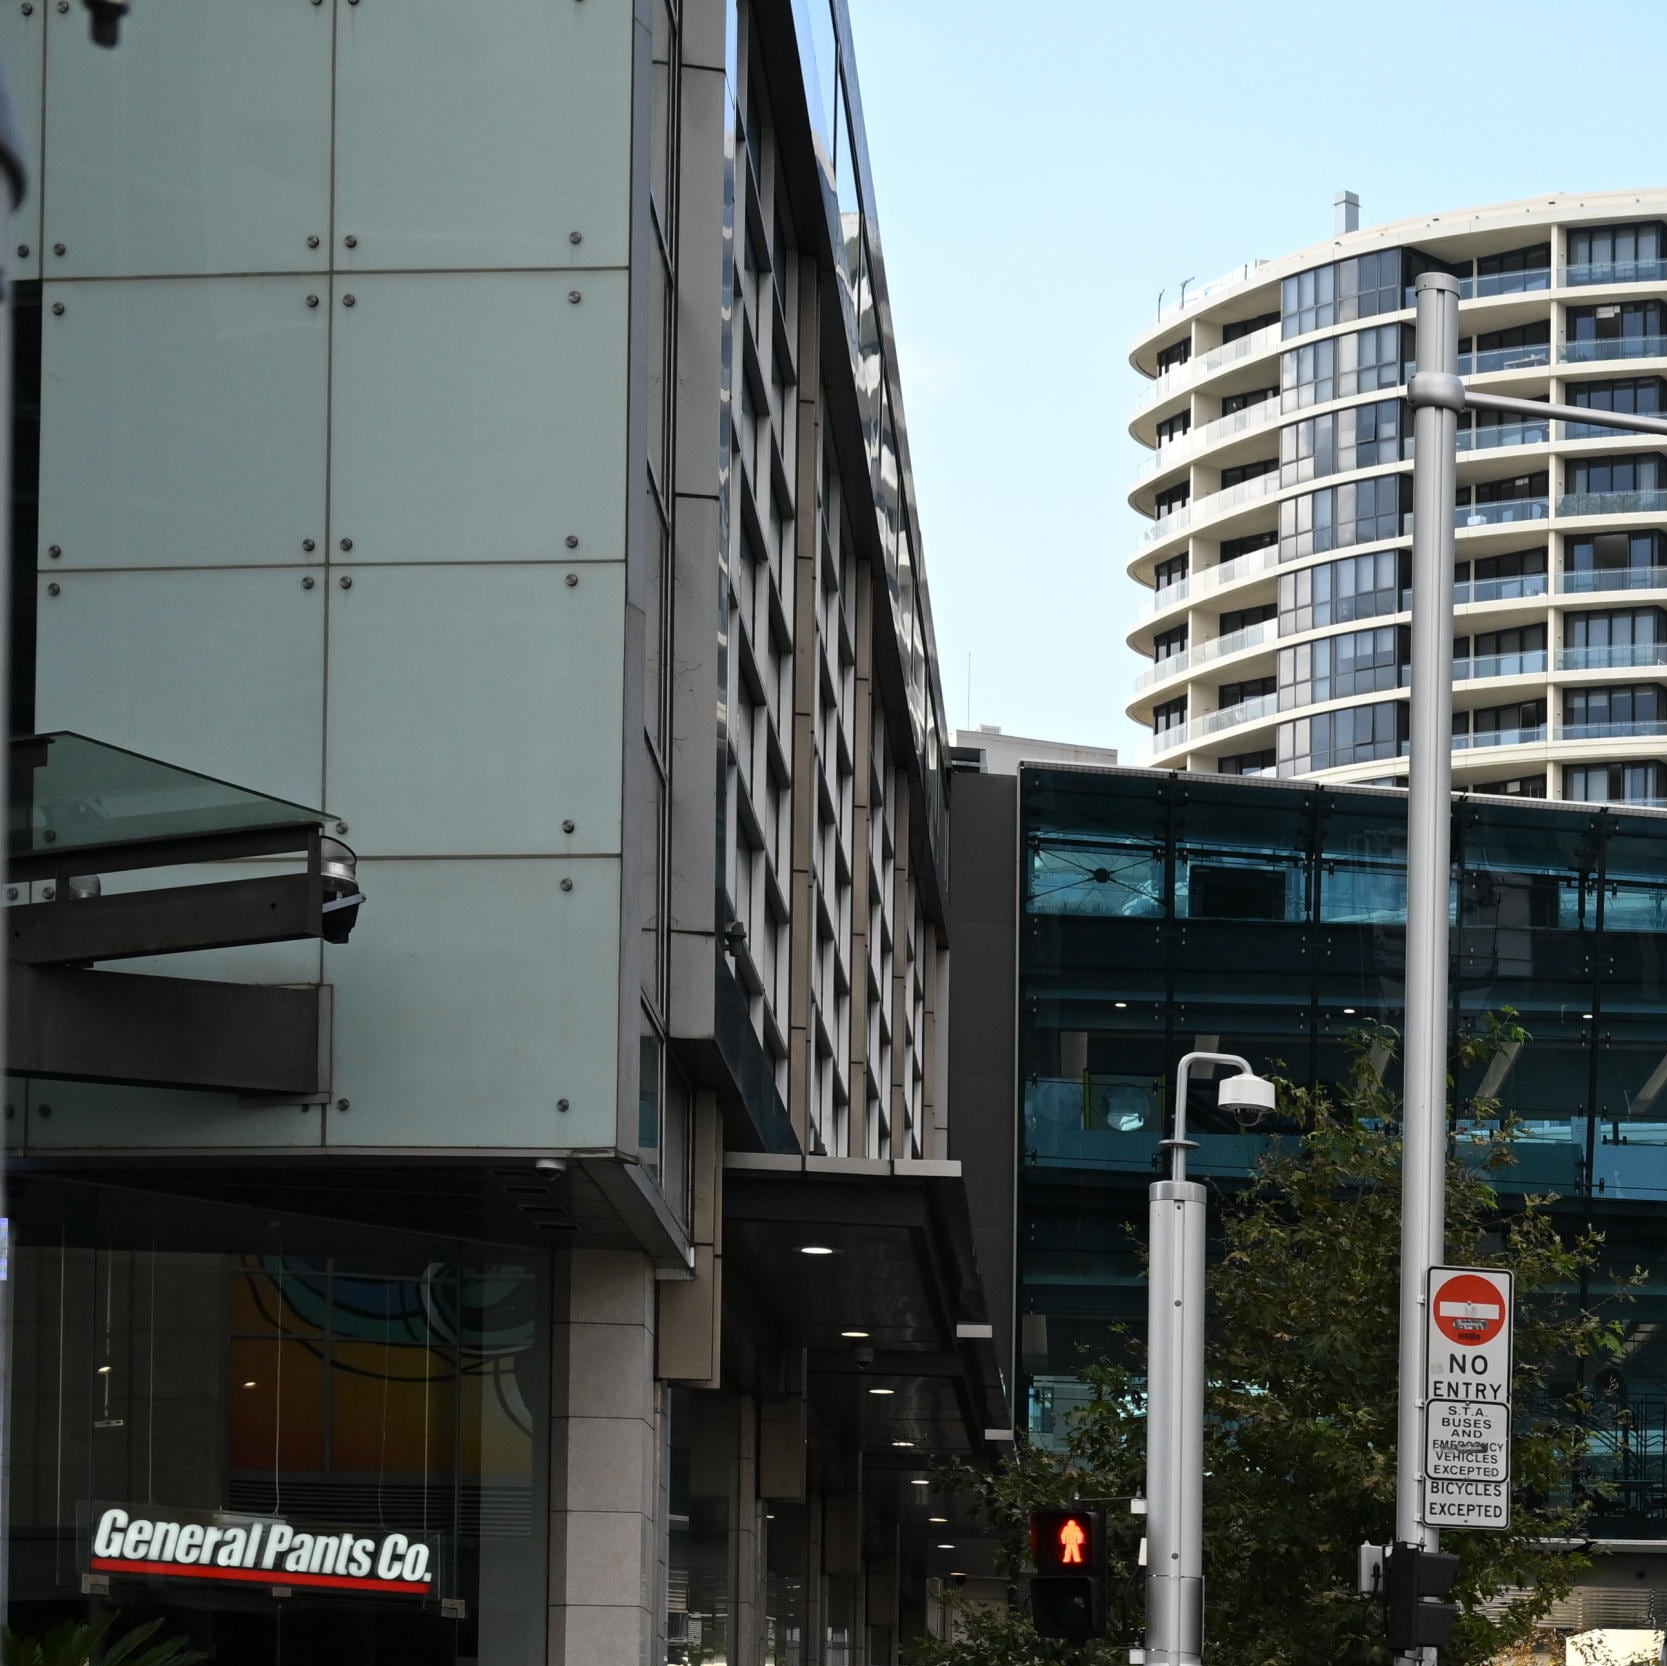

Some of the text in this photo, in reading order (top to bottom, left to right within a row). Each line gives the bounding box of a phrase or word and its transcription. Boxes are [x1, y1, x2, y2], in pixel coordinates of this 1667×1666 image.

[1449, 1354, 1488, 1376] NO
[1433, 1381, 1502, 1400] ENTRY
[1448, 1406, 1488, 1418] S.T.A.
[1441, 1418, 1492, 1430] BUSES
[1451, 1429, 1483, 1439] AND
[1436, 1451, 1498, 1464] VEHICLES
[1434, 1465, 1499, 1477] EXCEPTED
[1430, 1481, 1502, 1497] BICYCLES
[1429, 1502, 1503, 1518] EXCEPTED
[94, 1508, 432, 1583] General Pants Co.
